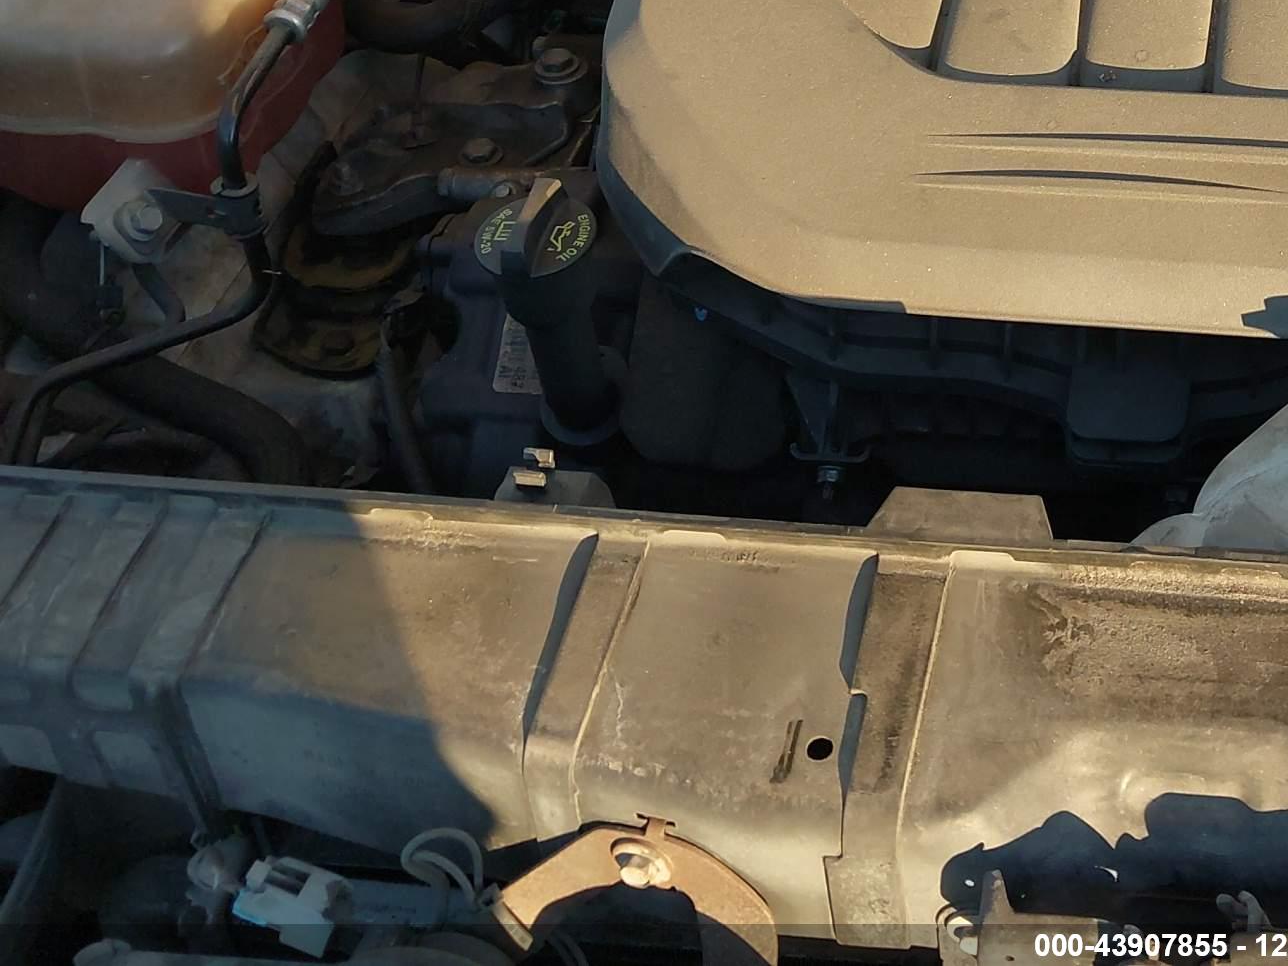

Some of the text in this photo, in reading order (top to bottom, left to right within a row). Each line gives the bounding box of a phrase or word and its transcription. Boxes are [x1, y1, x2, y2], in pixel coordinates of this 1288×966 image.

[490, 208, 513, 227] SAE
[555, 213, 592, 262] ENGINE OIL
